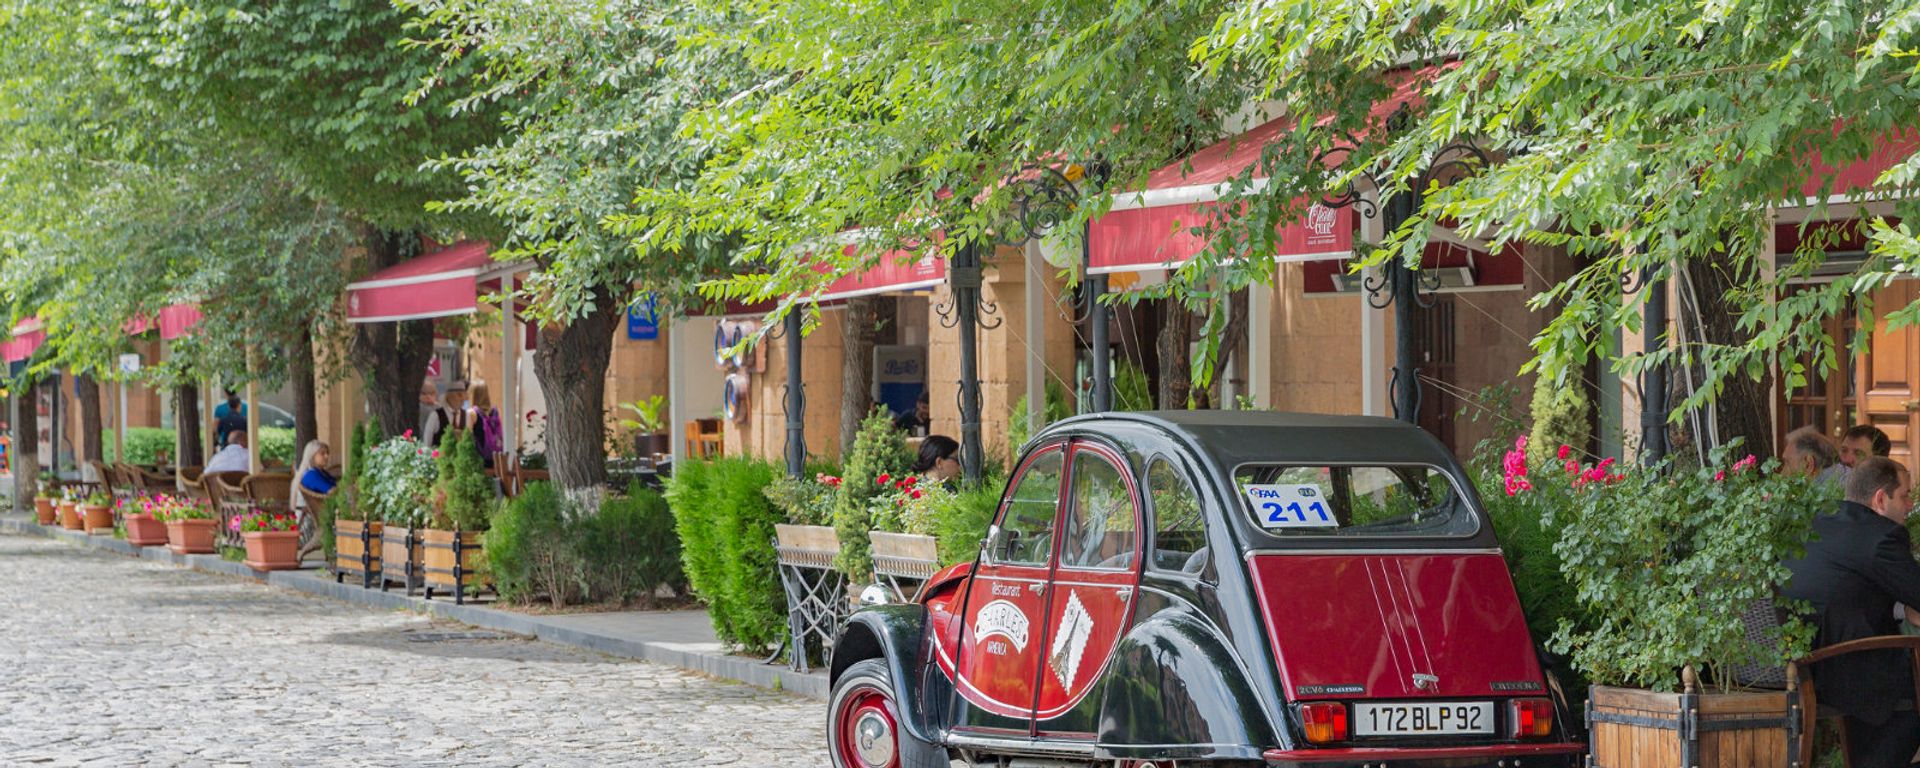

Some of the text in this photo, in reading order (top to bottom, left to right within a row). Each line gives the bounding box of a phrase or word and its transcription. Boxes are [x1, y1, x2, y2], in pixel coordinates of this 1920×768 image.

[1262, 501, 1329, 522] 211
[1369, 705, 1482, 731] 172 BLP 92
